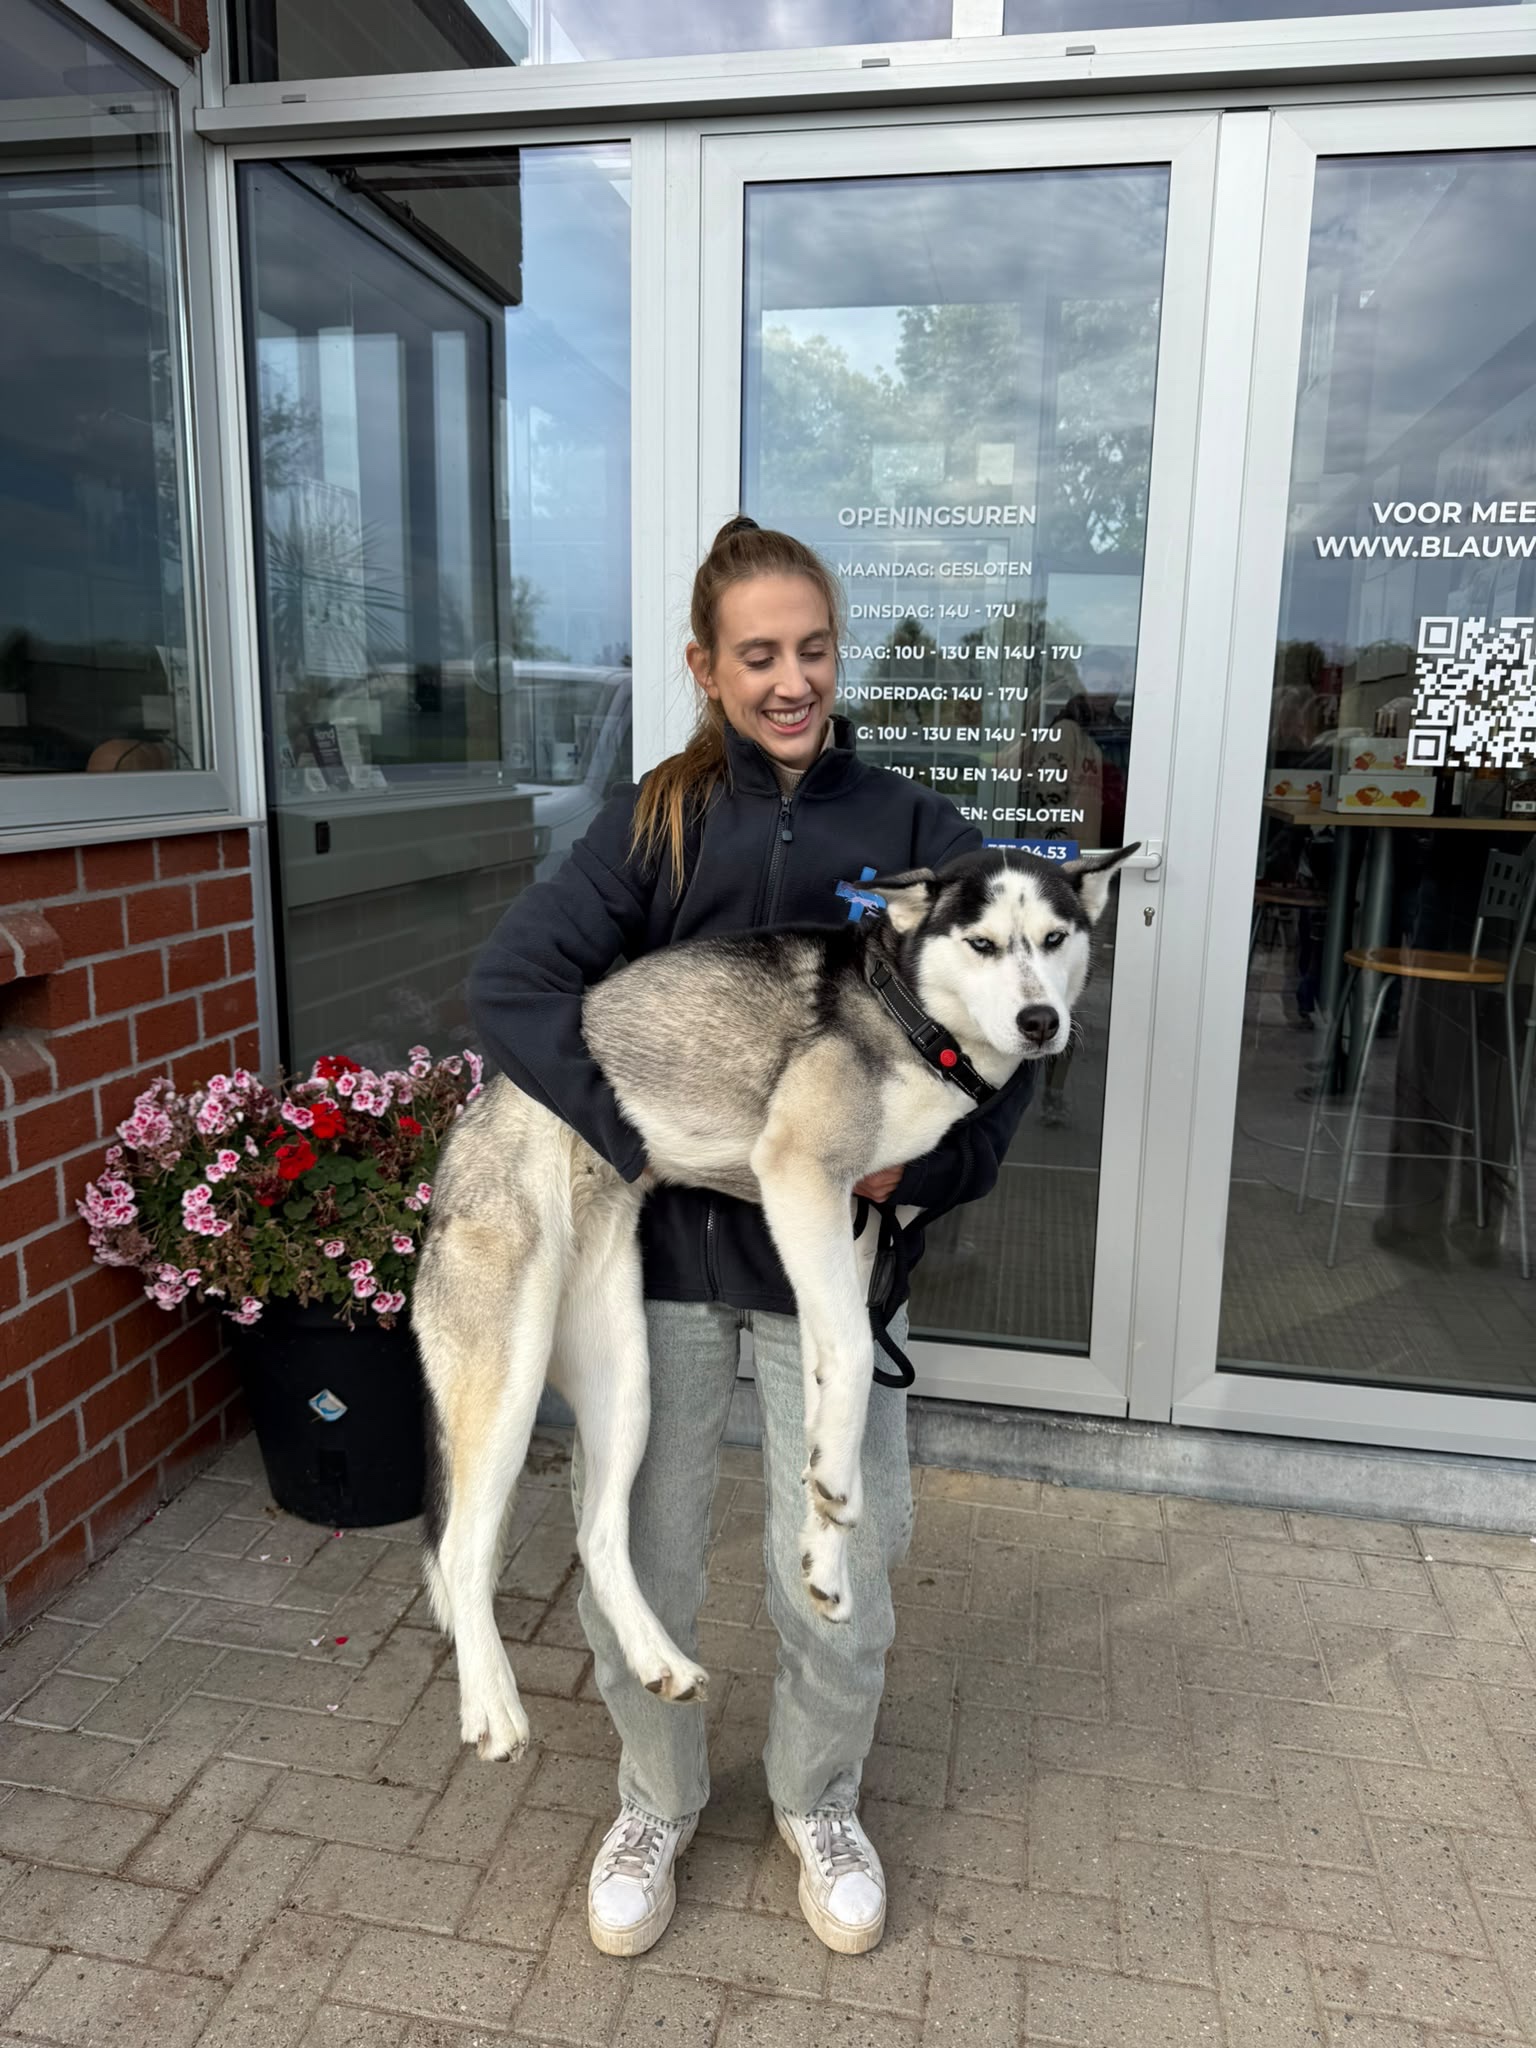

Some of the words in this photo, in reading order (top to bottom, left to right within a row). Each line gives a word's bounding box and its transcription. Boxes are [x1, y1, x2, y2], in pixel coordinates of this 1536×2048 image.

[838, 505, 1037, 527] OPENINGSUREN
[1373, 501, 1461, 524] VOOR
[1316, 535, 1536, 558] WWW.BLAUW
[838, 563, 935, 577] MAANDAG:
[939, 561, 1032, 576] GESLOTEN
[850, 604, 935, 618] DINSDAG:
[939, 604, 969, 618] 14U
[986, 604, 1016, 618] 17U
[840, 645, 890, 660] SDAG:
[895, 645, 925, 660] 10U
[942, 645, 970, 660] 13U
[975, 646, 999, 660] EN
[1004, 645, 1035, 660] 14U
[1052, 645, 1083, 660] 17U
[952, 687, 982, 701] 14U
[999, 687, 1029, 701] 17U
[877, 726, 907, 740] 10U
[922, 727, 951, 741] 13U
[956, 727, 980, 741] EN
[984, 727, 1015, 741] 14U
[1031, 728, 1062, 742] 17U
[929, 767, 958, 781] 13U
[963, 768, 986, 782] EN
[991, 768, 1022, 782] 14U
[1037, 768, 1068, 783] 17U
[992, 807, 1085, 823] GESLOTEN
